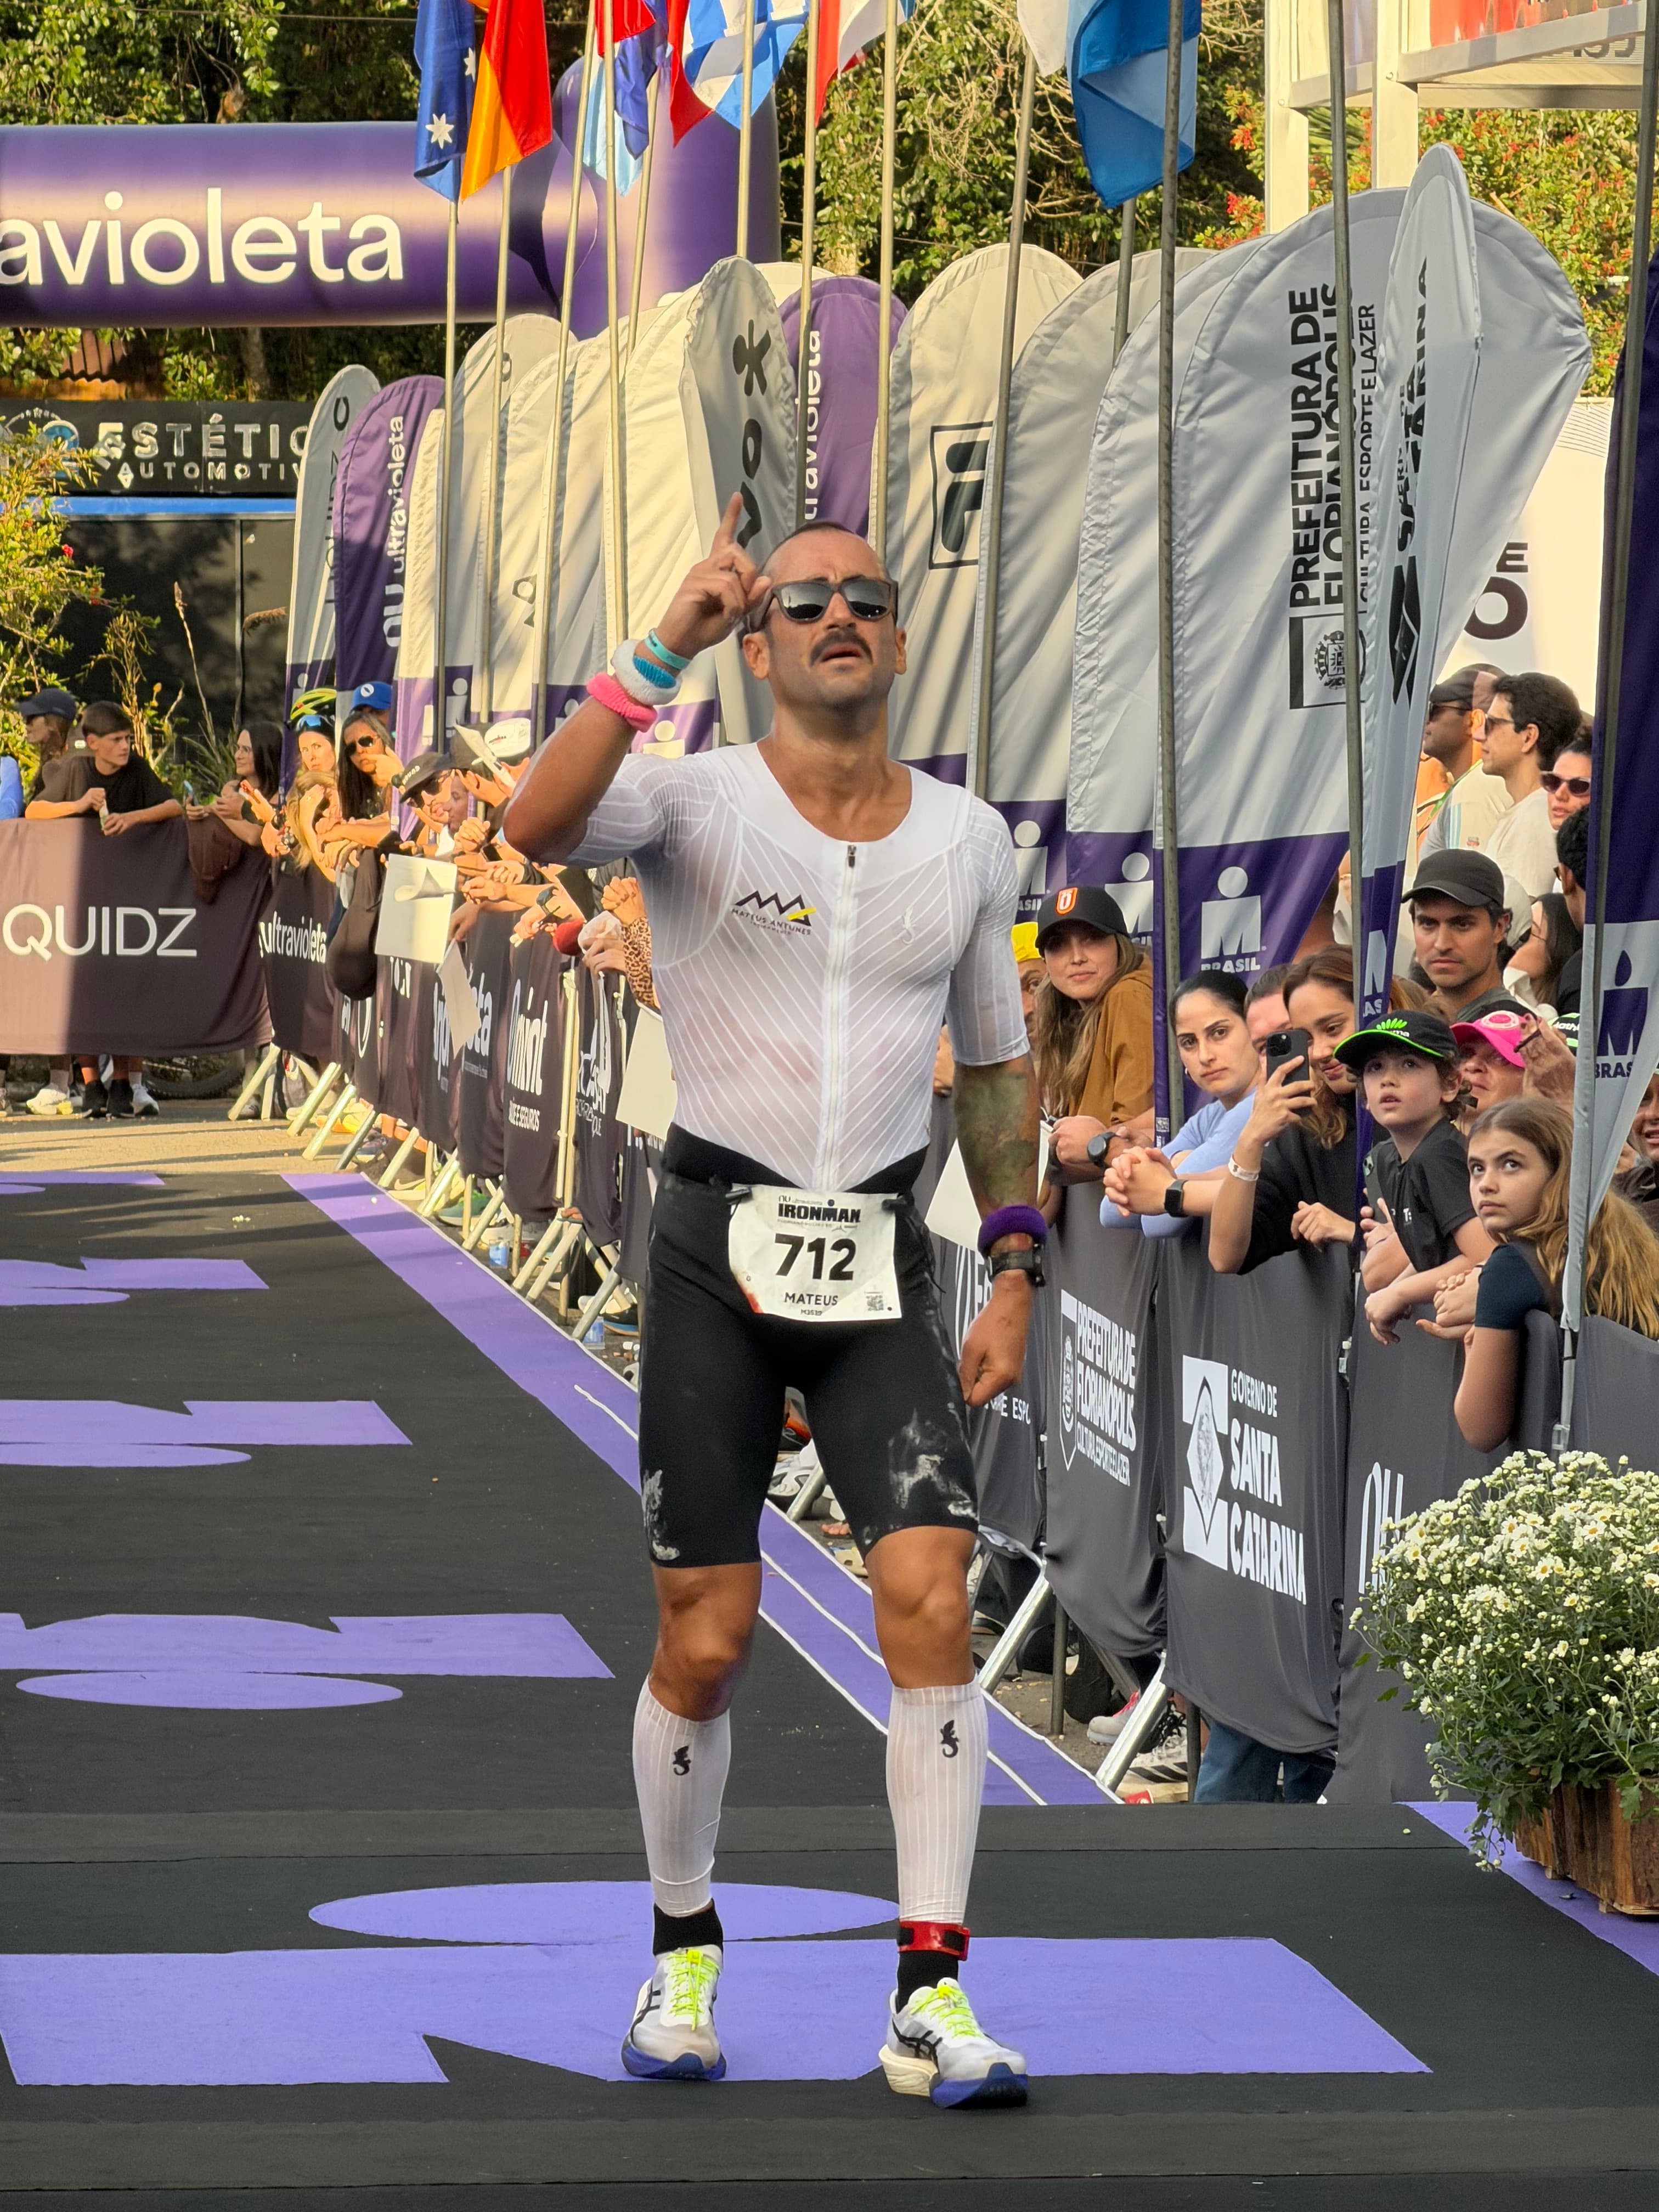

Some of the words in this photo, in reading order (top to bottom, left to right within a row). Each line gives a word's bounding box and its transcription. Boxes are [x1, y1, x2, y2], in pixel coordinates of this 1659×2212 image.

[1289, 287, 1321, 345] DE
[1358, 304, 1378, 374] LAZER
[388, 415, 407, 574] ultravioleta
[1289, 351, 1324, 608] PREFEITURA
[2, 904, 198, 961] QUIDZ
[731, 908, 766, 923] MATEUS
[770, 919, 812, 935] ANTUNES
[778, 1201, 861, 1223] IRONMAN
[774, 1233, 856, 1281] 712
[784, 1292, 839, 1306] MATEUS
[1077, 1300, 1123, 1384] PREFEITURA
[1076, 1359, 1137, 1452] FLORIANÓPOLIS
[1231, 1368, 1266, 1415] GOVERNO
[1267, 1384, 1278, 1418] DE
[1230, 1417, 1283, 1507] SANTA
[1229, 1501, 1307, 1606] CATARINA
